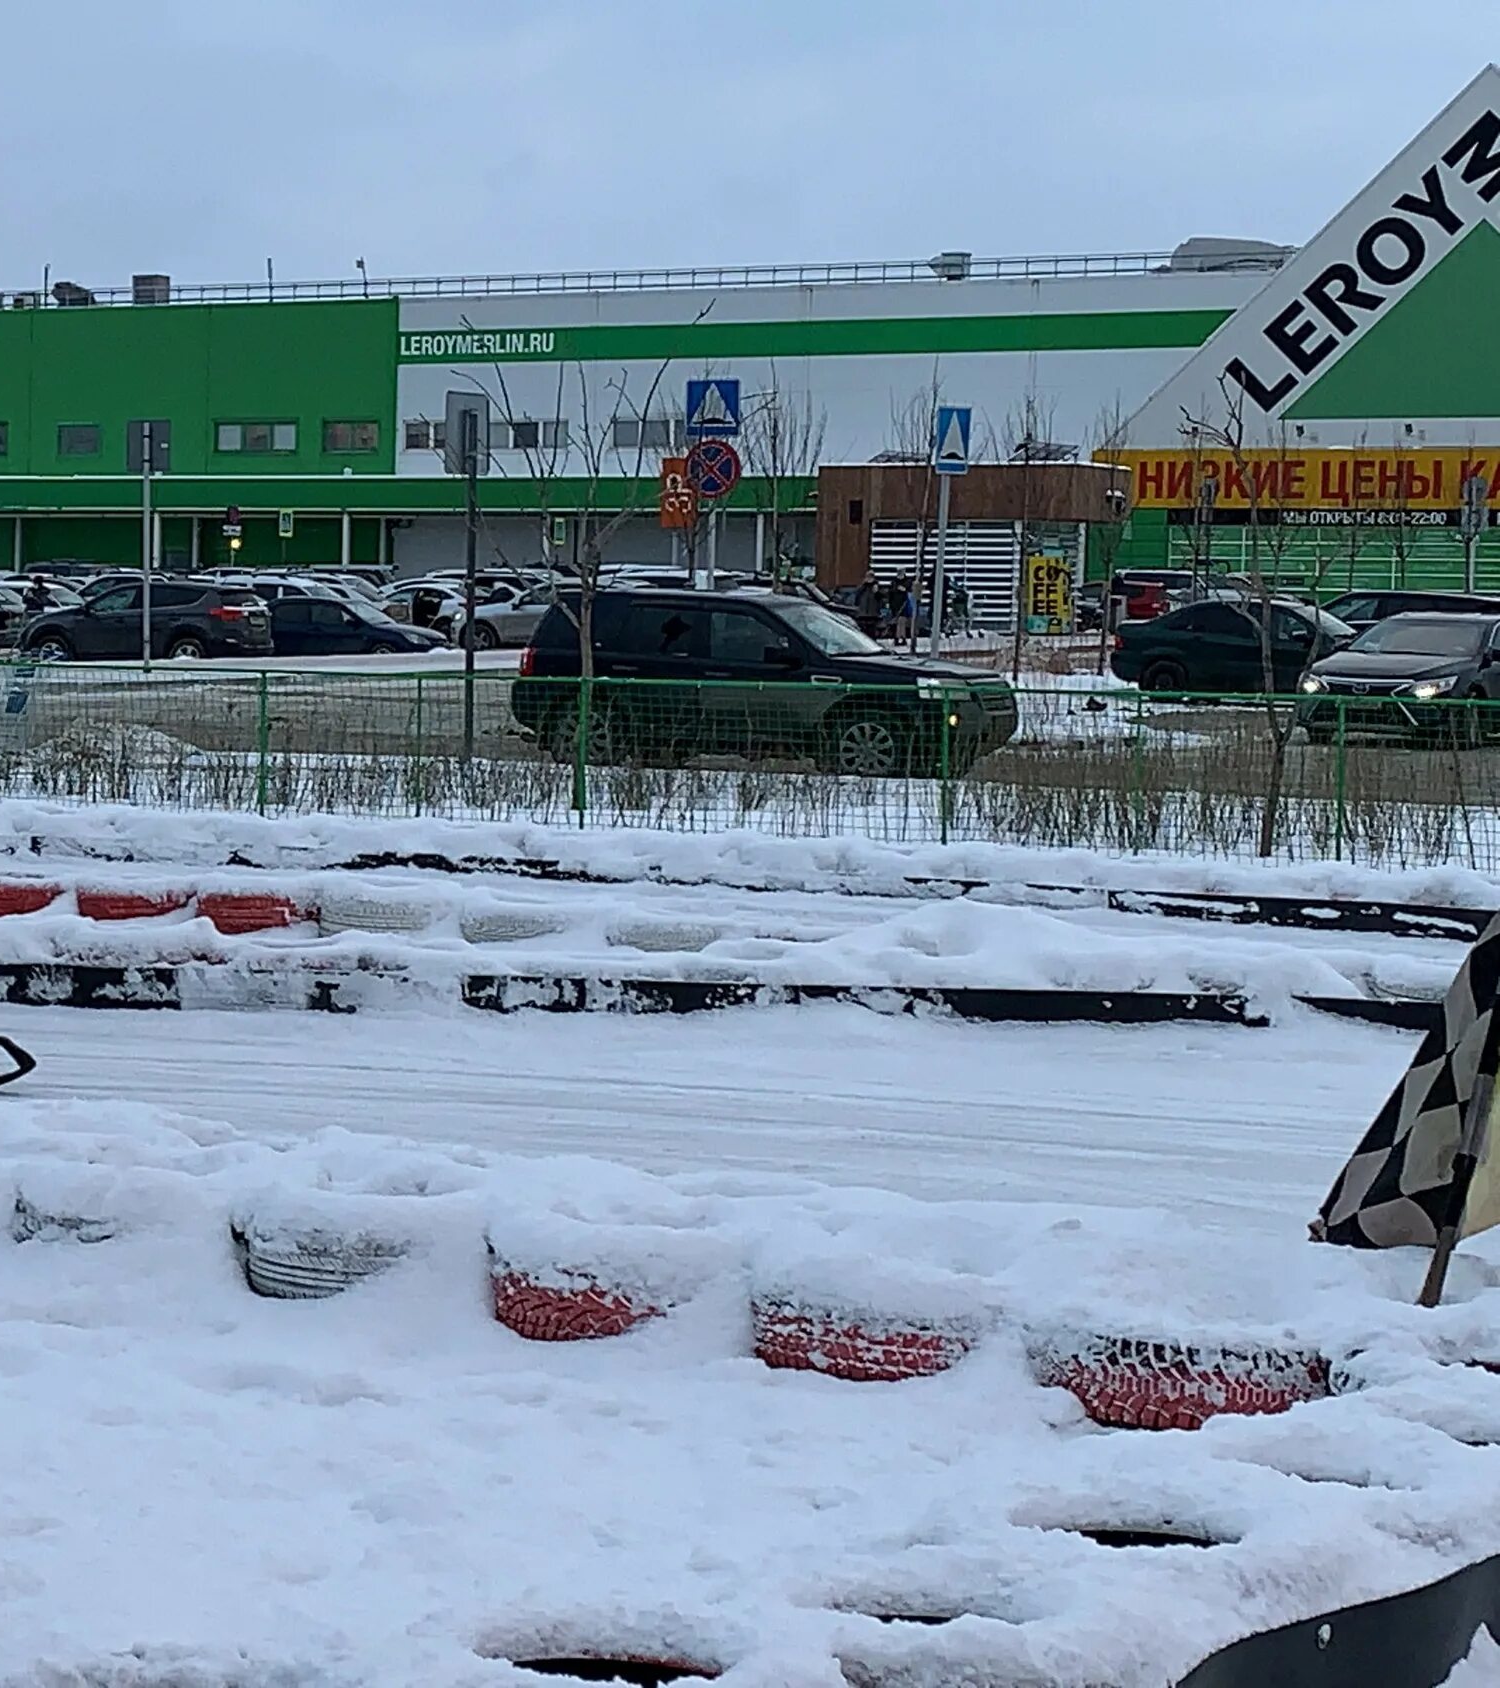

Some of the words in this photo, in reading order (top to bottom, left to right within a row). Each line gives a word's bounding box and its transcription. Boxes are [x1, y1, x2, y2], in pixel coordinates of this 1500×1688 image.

[400, 332, 555, 356] LEROYMERLIN.RU
[1138, 460, 1306, 499] НИЗКИЕ
[1320, 460, 1442, 507] ЦЕНЫ
[1309, 510, 1375, 524] ОТКРЫТЫ
